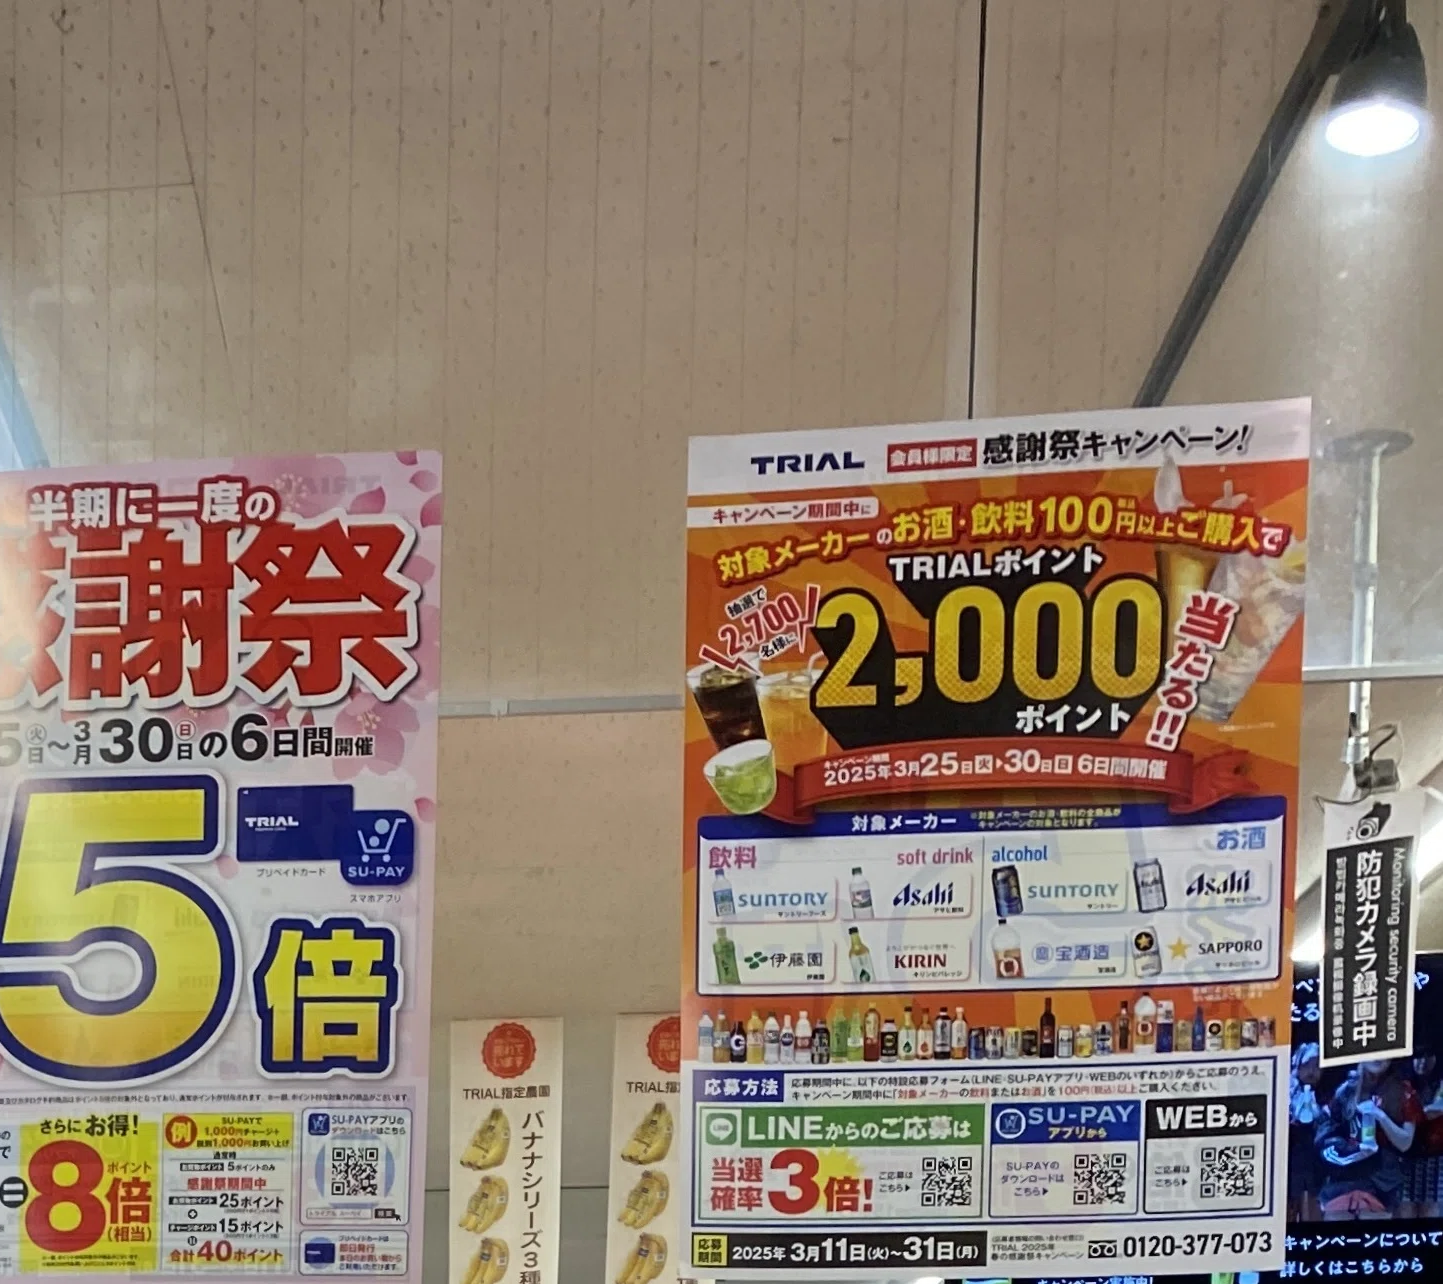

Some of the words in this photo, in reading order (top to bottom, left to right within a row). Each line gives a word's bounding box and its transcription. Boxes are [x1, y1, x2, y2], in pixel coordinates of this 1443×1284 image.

[751, 452, 865, 475] TRIAL
[29, 479, 275, 531] 半期に一度の
[889, 546, 1104, 581] TRIALポイント
[816, 578, 1162, 709] 2,000
[1015, 703, 1132, 734] ポイント
[245, 816, 299, 829] TRIAL
[852, 814, 957, 832] 対象メーカー
[1217, 827, 1266, 850] お酒
[708, 846, 757, 869] 飲料
[897, 848, 926, 865] soft
[932, 847, 973, 865] drink
[992, 846, 1048, 862] alcohol
[347, 865, 405, 878] SU-PAY
[1186, 870, 1251, 896] Asahi
[893, 882, 954, 907] Asahi
[1027, 883, 1120, 899] SUNTORY
[1390, 847, 1408, 925] Monitoring
[738, 892, 828, 907] SUNTORY
[1198, 940, 1262, 954] SAPPORO
[1351, 851, 1384, 1047] 防犯カメラ録画中
[1387, 926, 1401, 987] security
[770, 952, 823, 967] 伊藤園
[894, 954, 947, 969] KIRIN
[258, 918, 395, 1073] 倍
[1387, 989, 1398, 1042] camera
[704, 1079, 778, 1097] 応募方法
[1028, 1105, 1135, 1126] SU-PAY
[1156, 1104, 1258, 1130] WEBから
[747, 1116, 971, 1141] LINEからのご応募は
[1048, 1127, 1107, 1140] アプリから
[107, 1161, 152, 1173] ポイント
[711, 1157, 763, 1183] 当選
[220, 1194, 284, 1208] 25ポイント
[710, 1186, 763, 1211] 確率
[220, 1219, 284, 1232] 15ポイント
[1124, 1232, 1273, 1257] 0120-377-073
